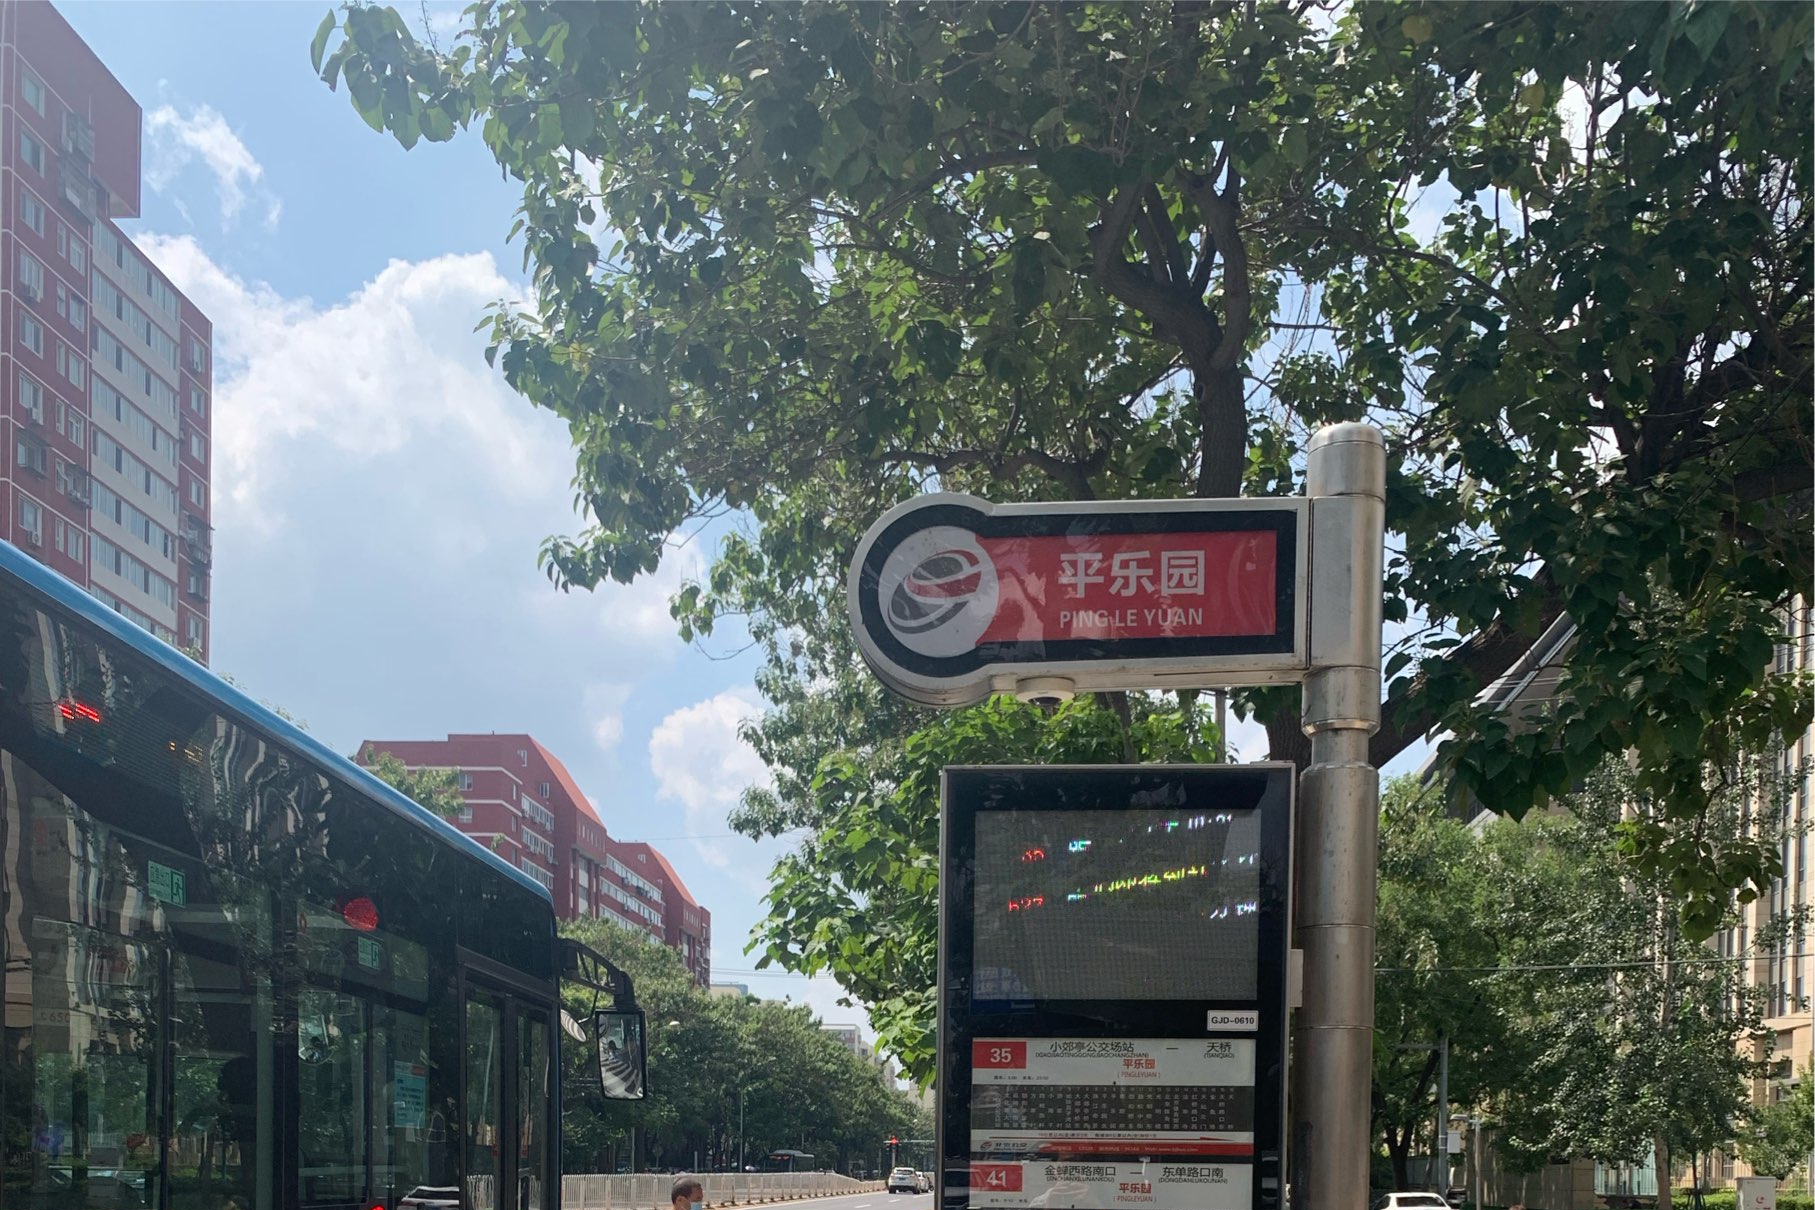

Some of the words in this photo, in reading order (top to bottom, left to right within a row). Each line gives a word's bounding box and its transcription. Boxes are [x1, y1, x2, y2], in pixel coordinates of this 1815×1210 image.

[1058, 550, 1205, 598] 平乐园
[1060, 610, 1108, 628] PING
[1144, 608, 1203, 627] YUAN
[1211, 1016, 1254, 1024] GJD-0610
[1050, 1041, 1134, 1052] 小郊亭公交场站
[1207, 1041, 1232, 1053] 天桥
[990, 1047, 1012, 1063] 35
[1123, 1058, 1155, 1069] 平乐园
[1045, 1165, 1116, 1176] 金蝉西路南口
[1163, 1167, 1224, 1178] 东单路口南
[987, 1170, 1007, 1187] 41
[1119, 1183, 1151, 1194] 平乐园
